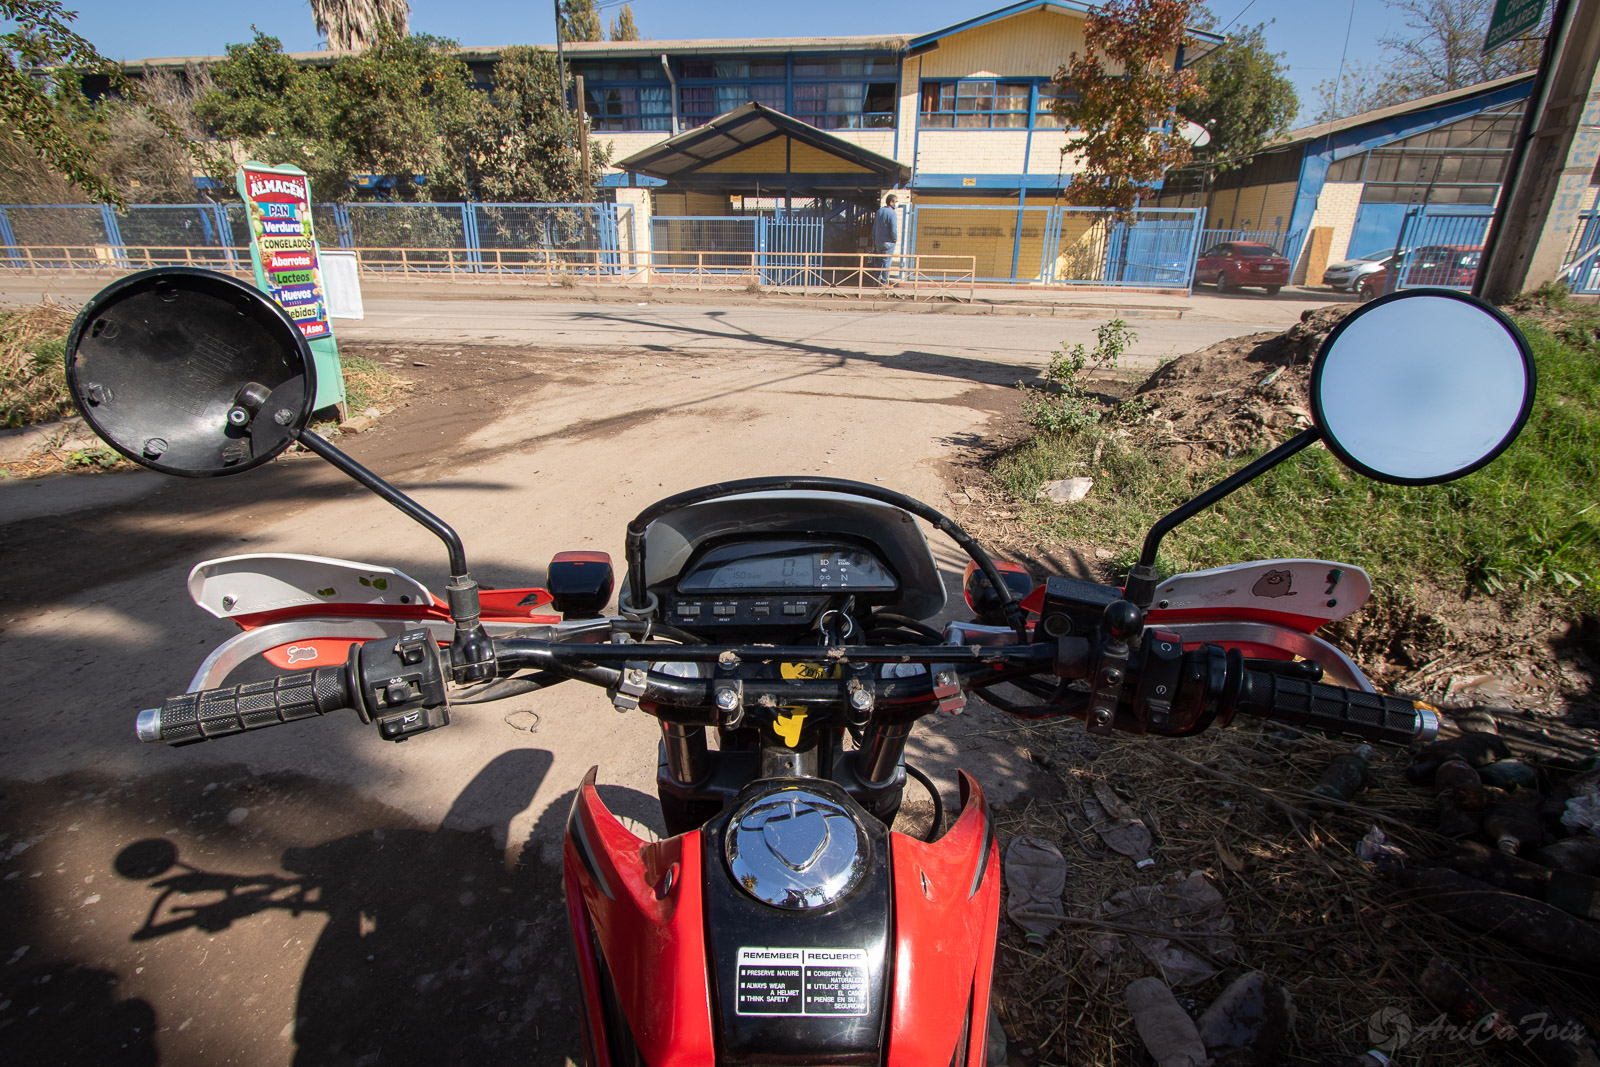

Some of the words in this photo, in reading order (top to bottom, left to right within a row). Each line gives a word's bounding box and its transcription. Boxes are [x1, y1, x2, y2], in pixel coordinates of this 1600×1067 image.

[1505, 0, 1531, 16] CRU
[1488, 1, 1540, 44] ESCOLARES
[269, 204, 289, 217] PAN
[264, 221, 305, 233] Verduras
[264, 239, 312, 249] CONGELADOS
[272, 256, 310, 267] Abarrotes
[277, 273, 310, 284] Lacteos
[281, 289, 311, 301] Huevos
[306, 324, 323, 334] Aseo
[782, 559, 796, 577] 0
[840, 574, 848, 582] N
